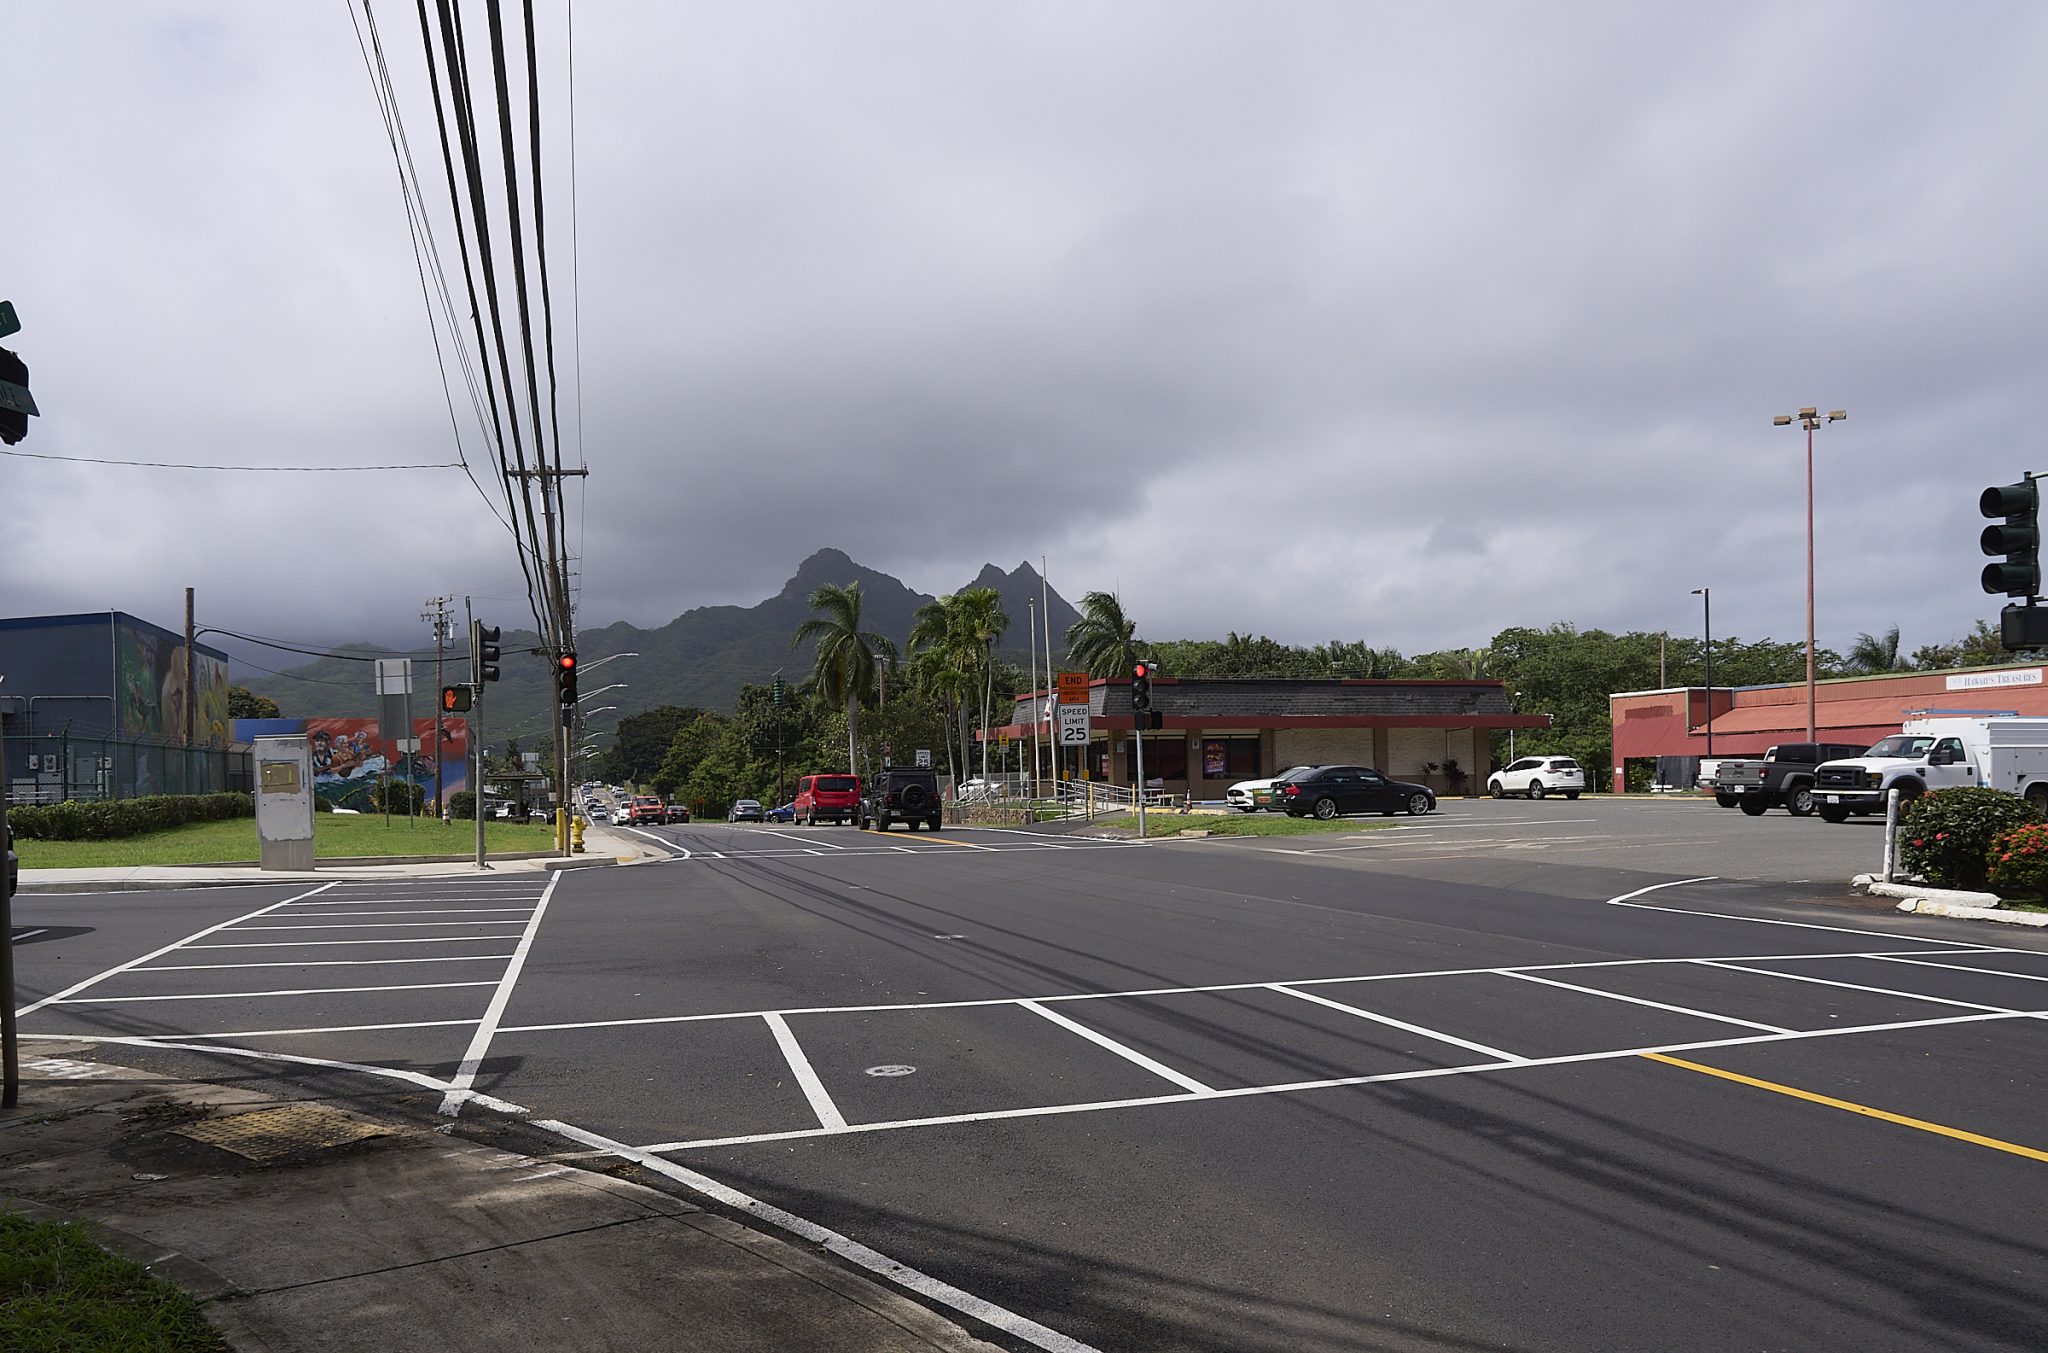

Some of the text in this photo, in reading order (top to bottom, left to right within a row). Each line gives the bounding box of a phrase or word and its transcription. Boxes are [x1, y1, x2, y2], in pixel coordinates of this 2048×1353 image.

[1065, 676, 1082, 685] END
[1998, 672, 2037, 684] TREASURES
[1061, 708, 1088, 716] SPEED
[1064, 727, 1087, 741] 25
